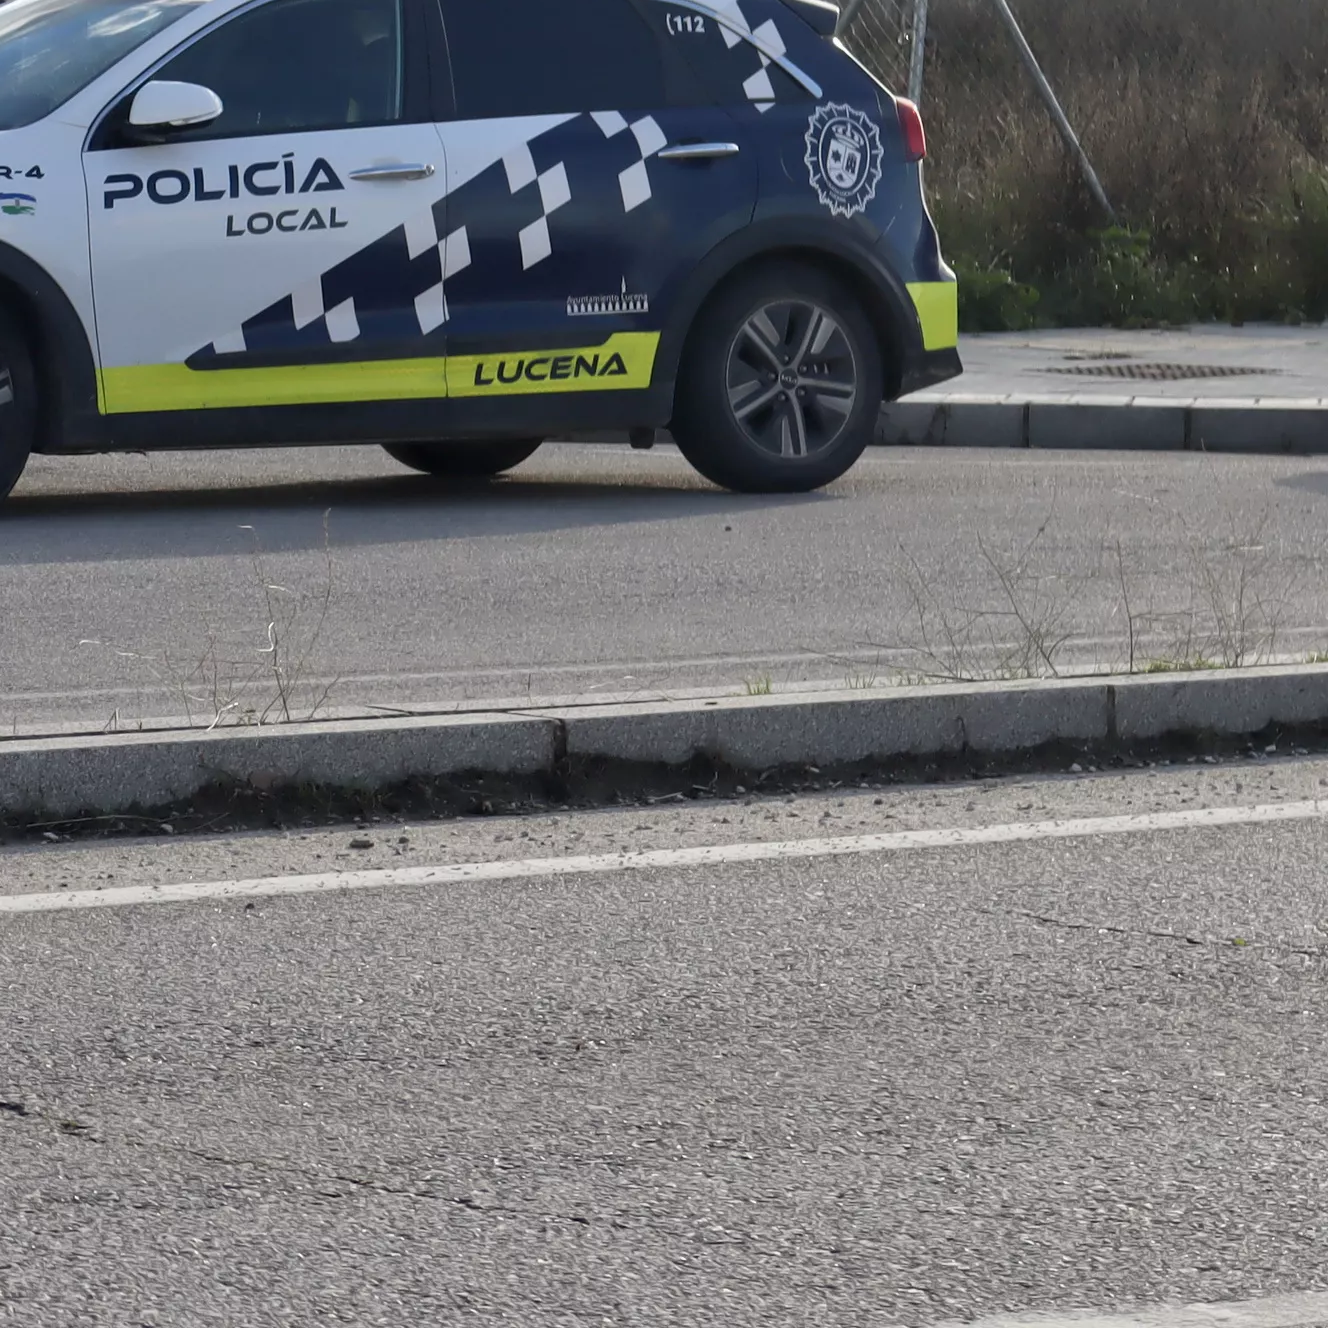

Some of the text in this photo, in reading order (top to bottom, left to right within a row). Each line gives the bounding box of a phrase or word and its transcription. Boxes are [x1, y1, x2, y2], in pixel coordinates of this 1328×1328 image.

[673, 15, 705, 32] 112
[103, 152, 345, 209] POLICÍA
[226, 207, 348, 237] LOCAL
[474, 352, 627, 386] LUCENA
